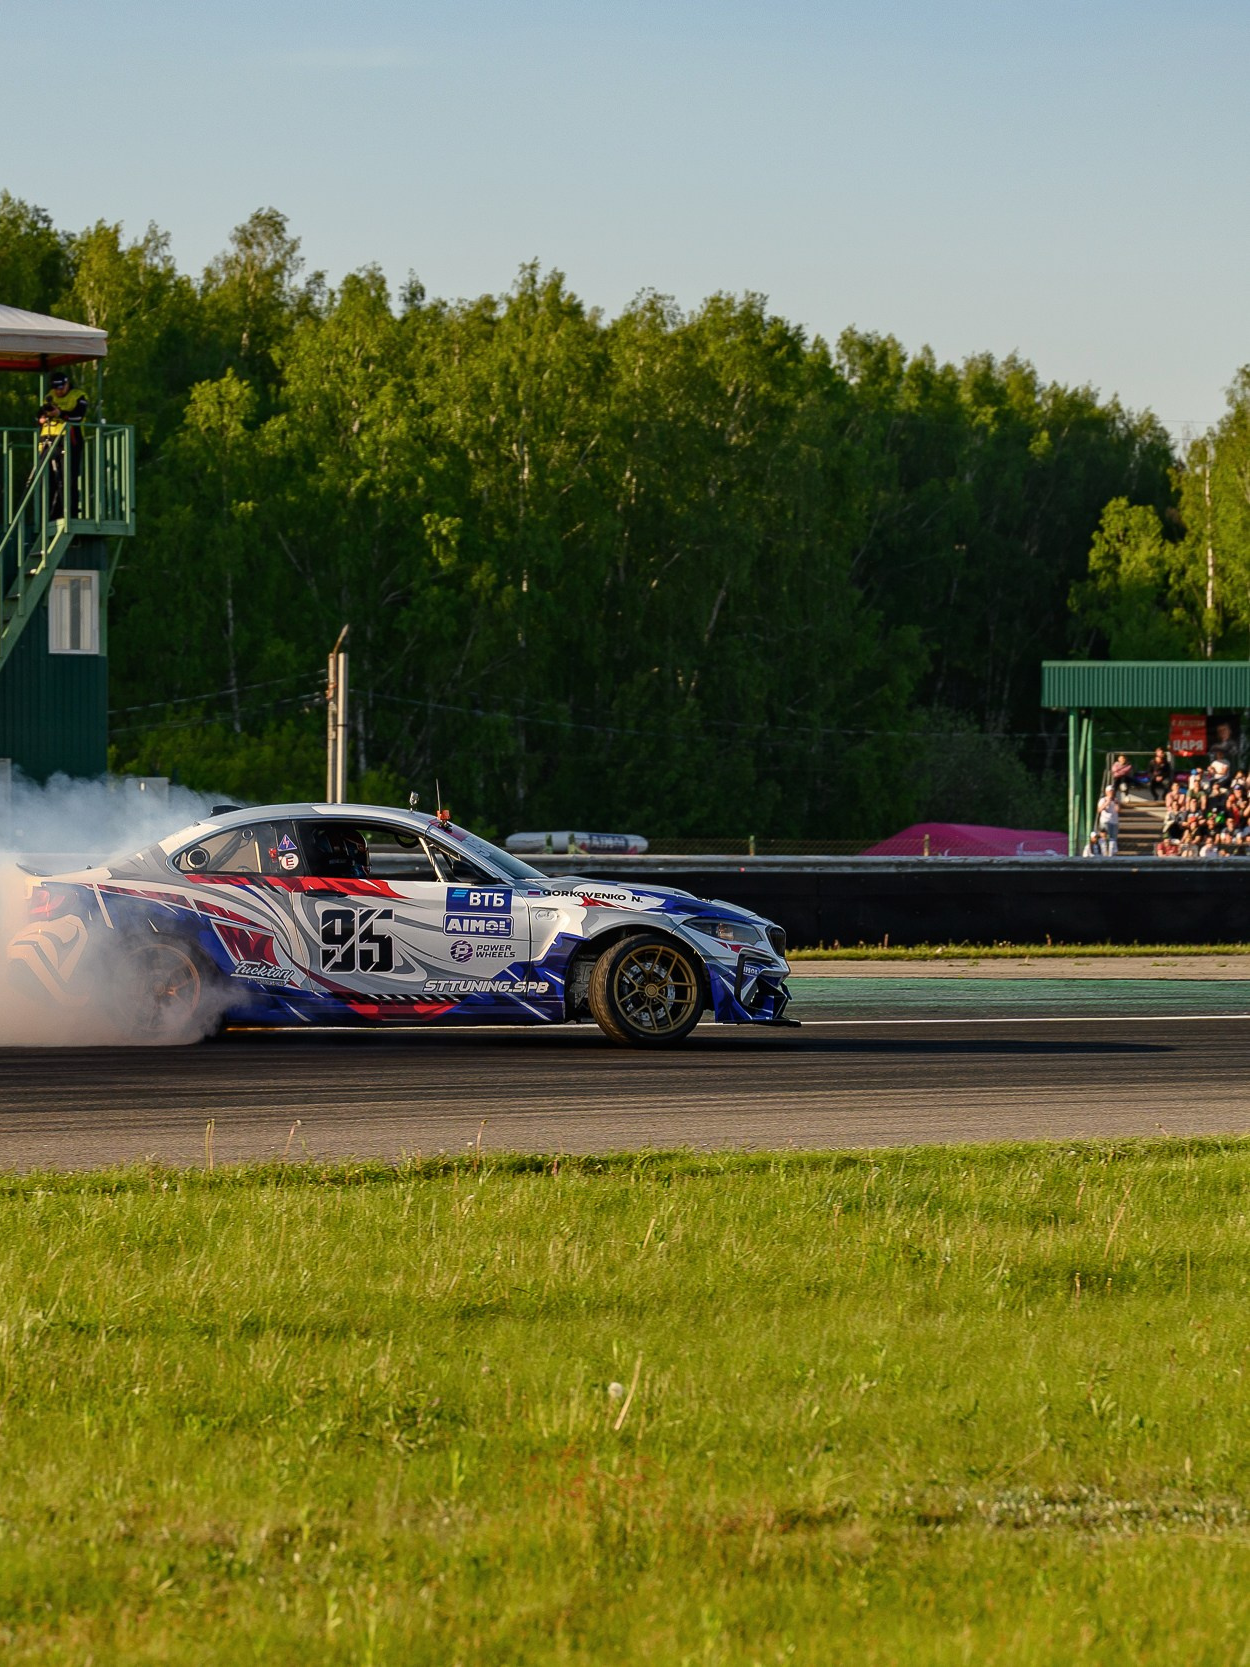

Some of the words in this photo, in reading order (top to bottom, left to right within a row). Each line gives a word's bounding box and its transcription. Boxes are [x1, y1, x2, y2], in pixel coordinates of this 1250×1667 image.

[469, 891, 505, 907] ВТБ
[542, 890, 627, 901] GORKOVENKO
[631, 896, 644, 904] N.
[446, 918, 510, 934] AIMOL
[320, 908, 395, 973] 95
[423, 979, 550, 994] STTUNING.SPB
